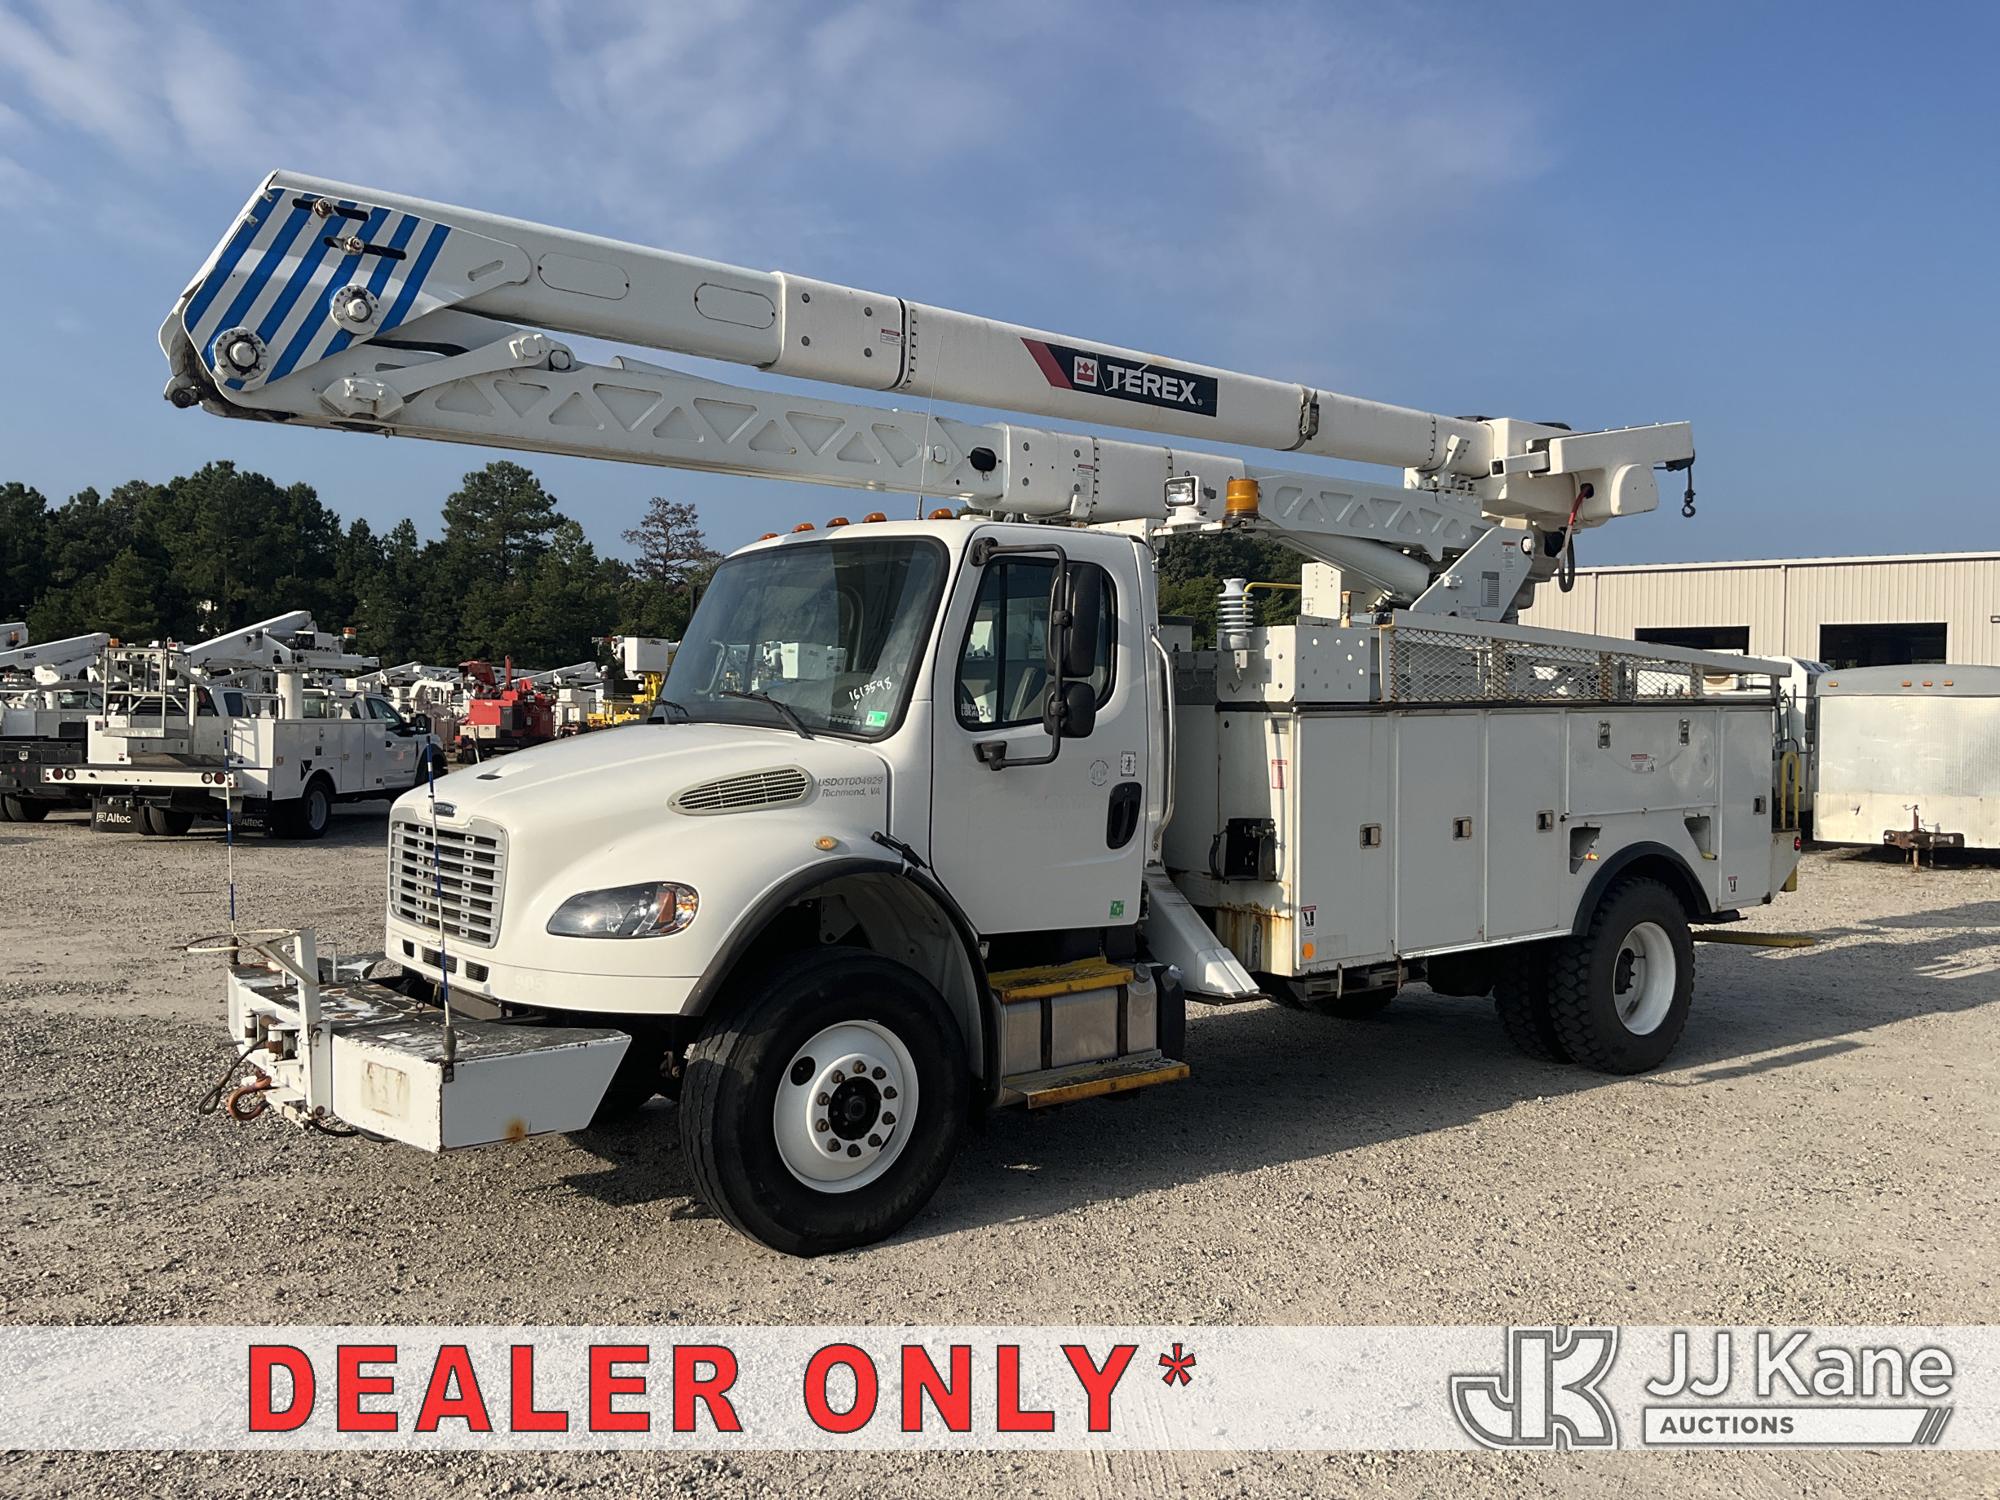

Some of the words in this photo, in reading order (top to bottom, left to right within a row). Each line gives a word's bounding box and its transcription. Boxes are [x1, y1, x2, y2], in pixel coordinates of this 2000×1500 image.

[1107, 364, 1197, 405] TEREX
[848, 676, 892, 701] 1613598
[822, 787, 867, 797] Richmond,
[870, 787, 881, 796] VA
[106, 812, 132, 824] Altec
[241, 818, 264, 827] Altec
